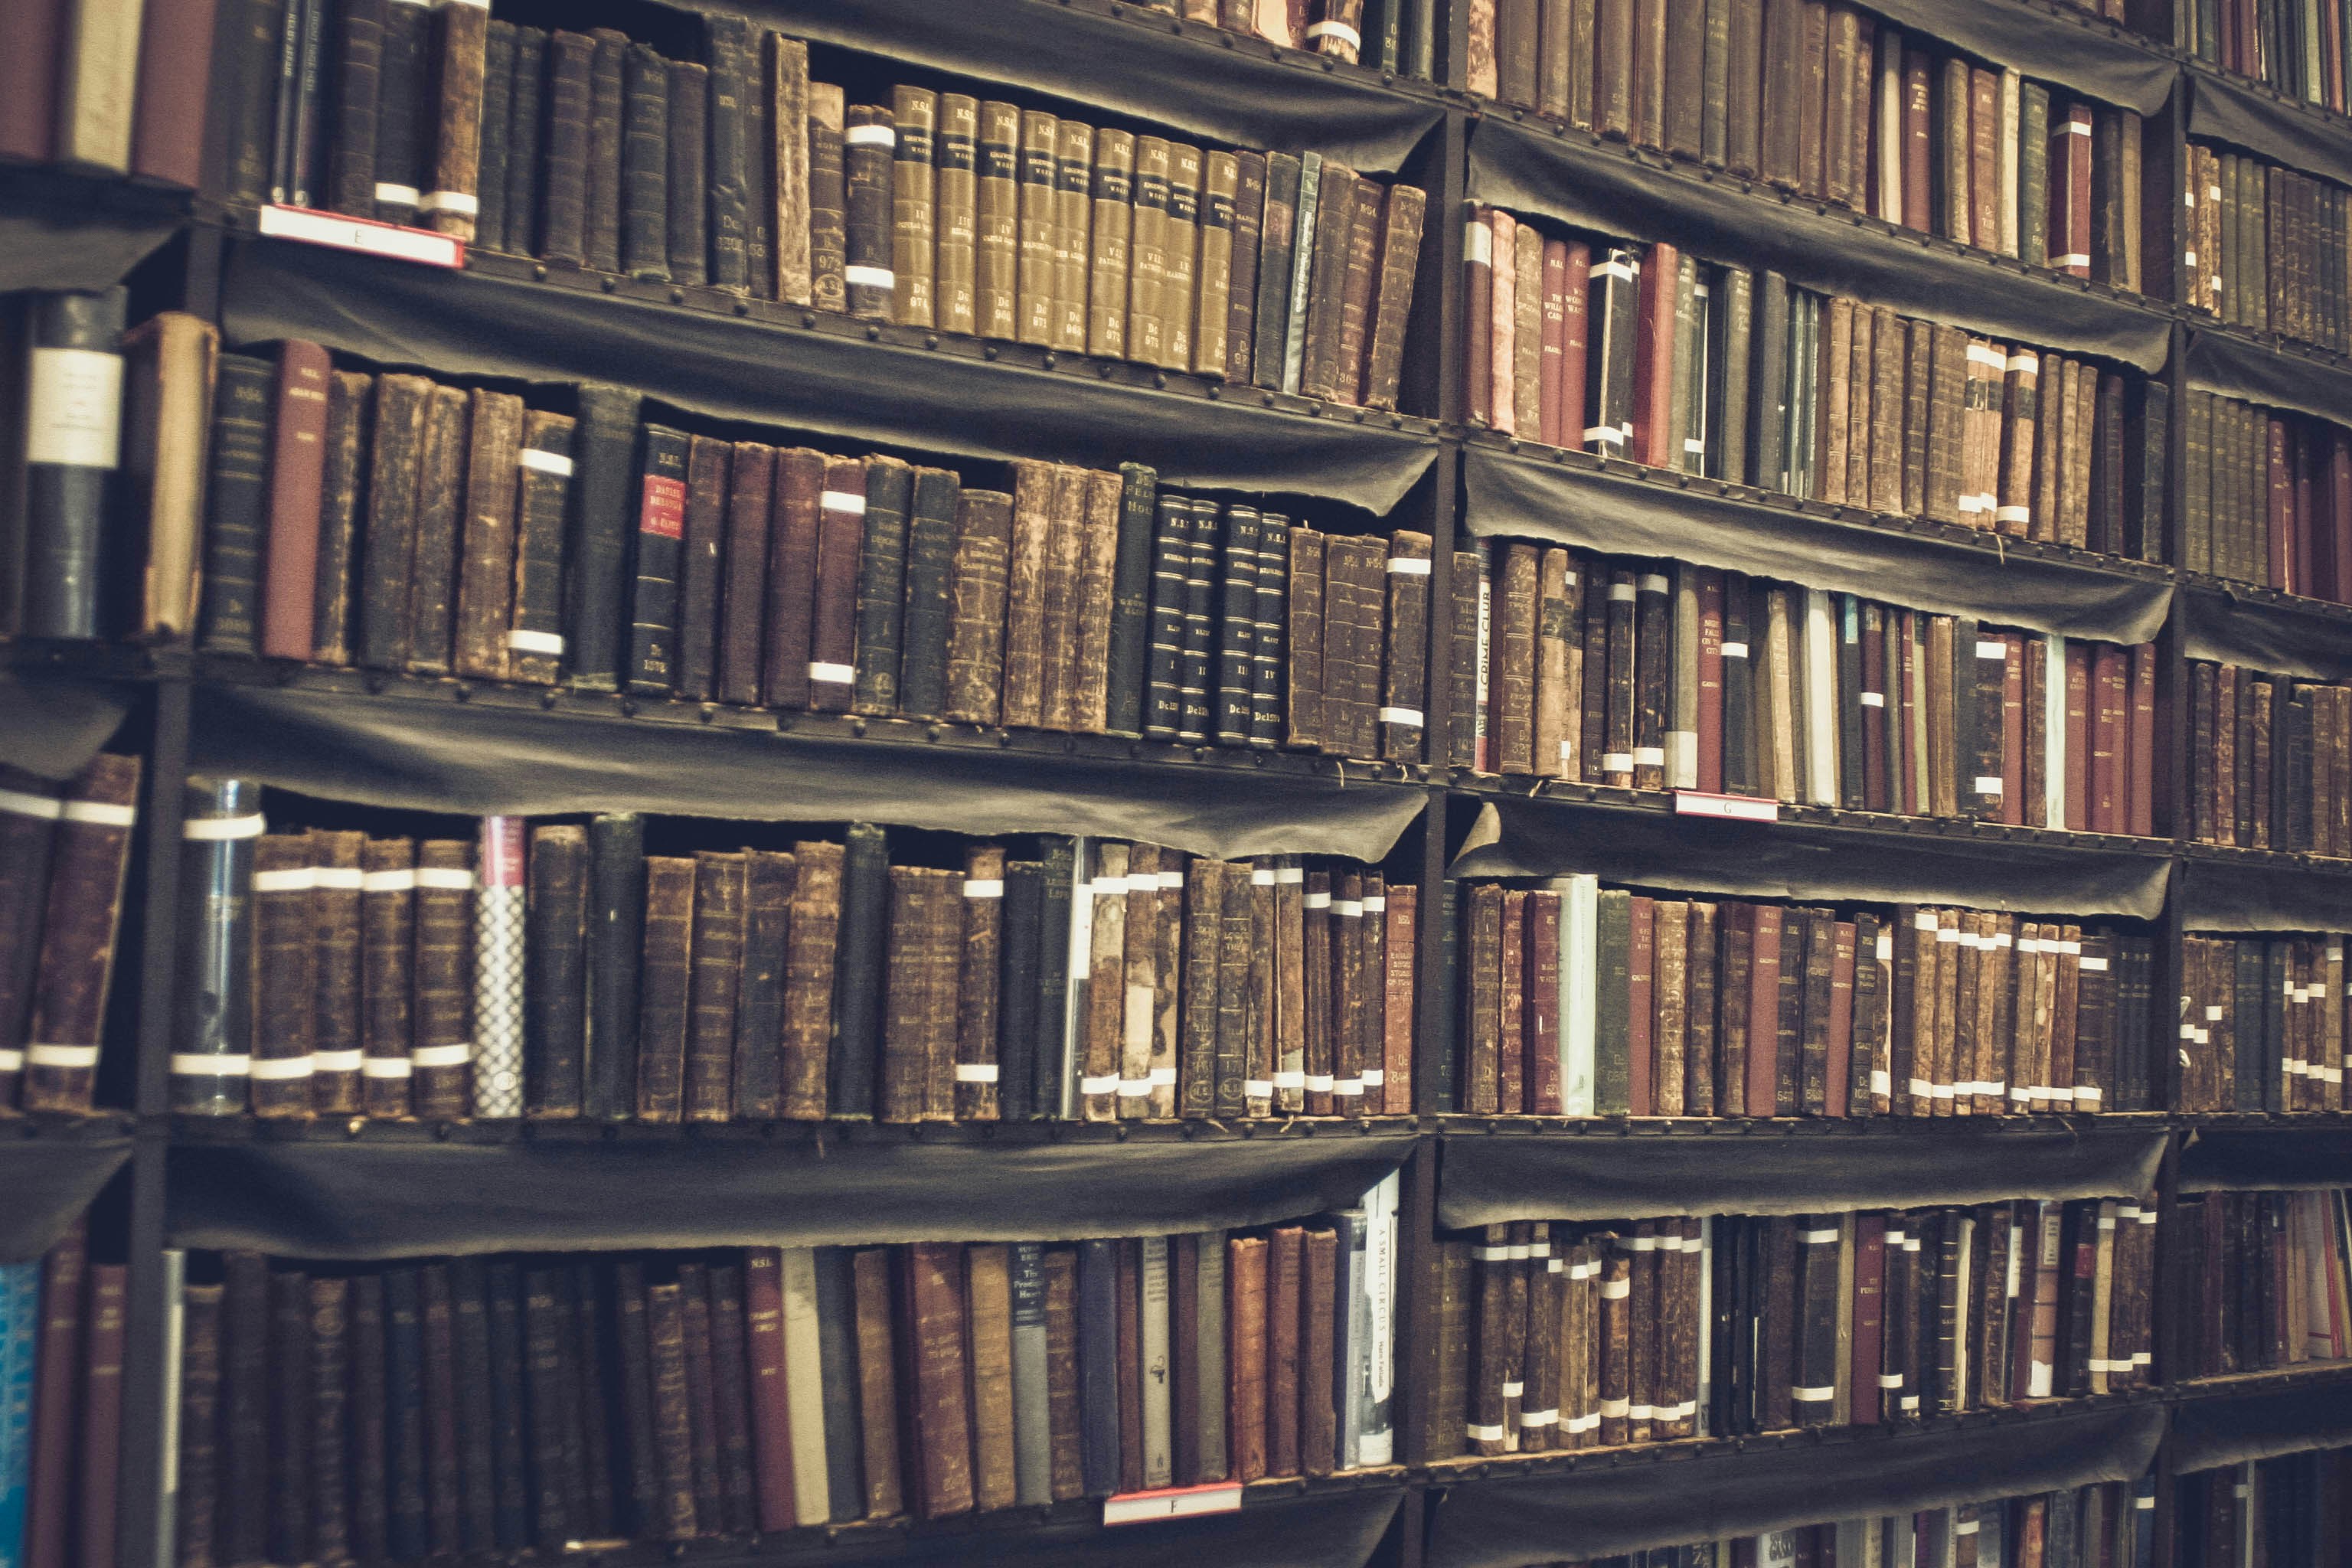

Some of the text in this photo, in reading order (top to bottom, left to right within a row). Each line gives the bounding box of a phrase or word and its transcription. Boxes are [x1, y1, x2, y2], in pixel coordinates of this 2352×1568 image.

[1724, 802, 1732, 814] G
[1378, 1241, 1387, 1278] SMALL
[1378, 1282, 1387, 1331] CIRCUS
[1171, 1500, 1178, 1514] F
